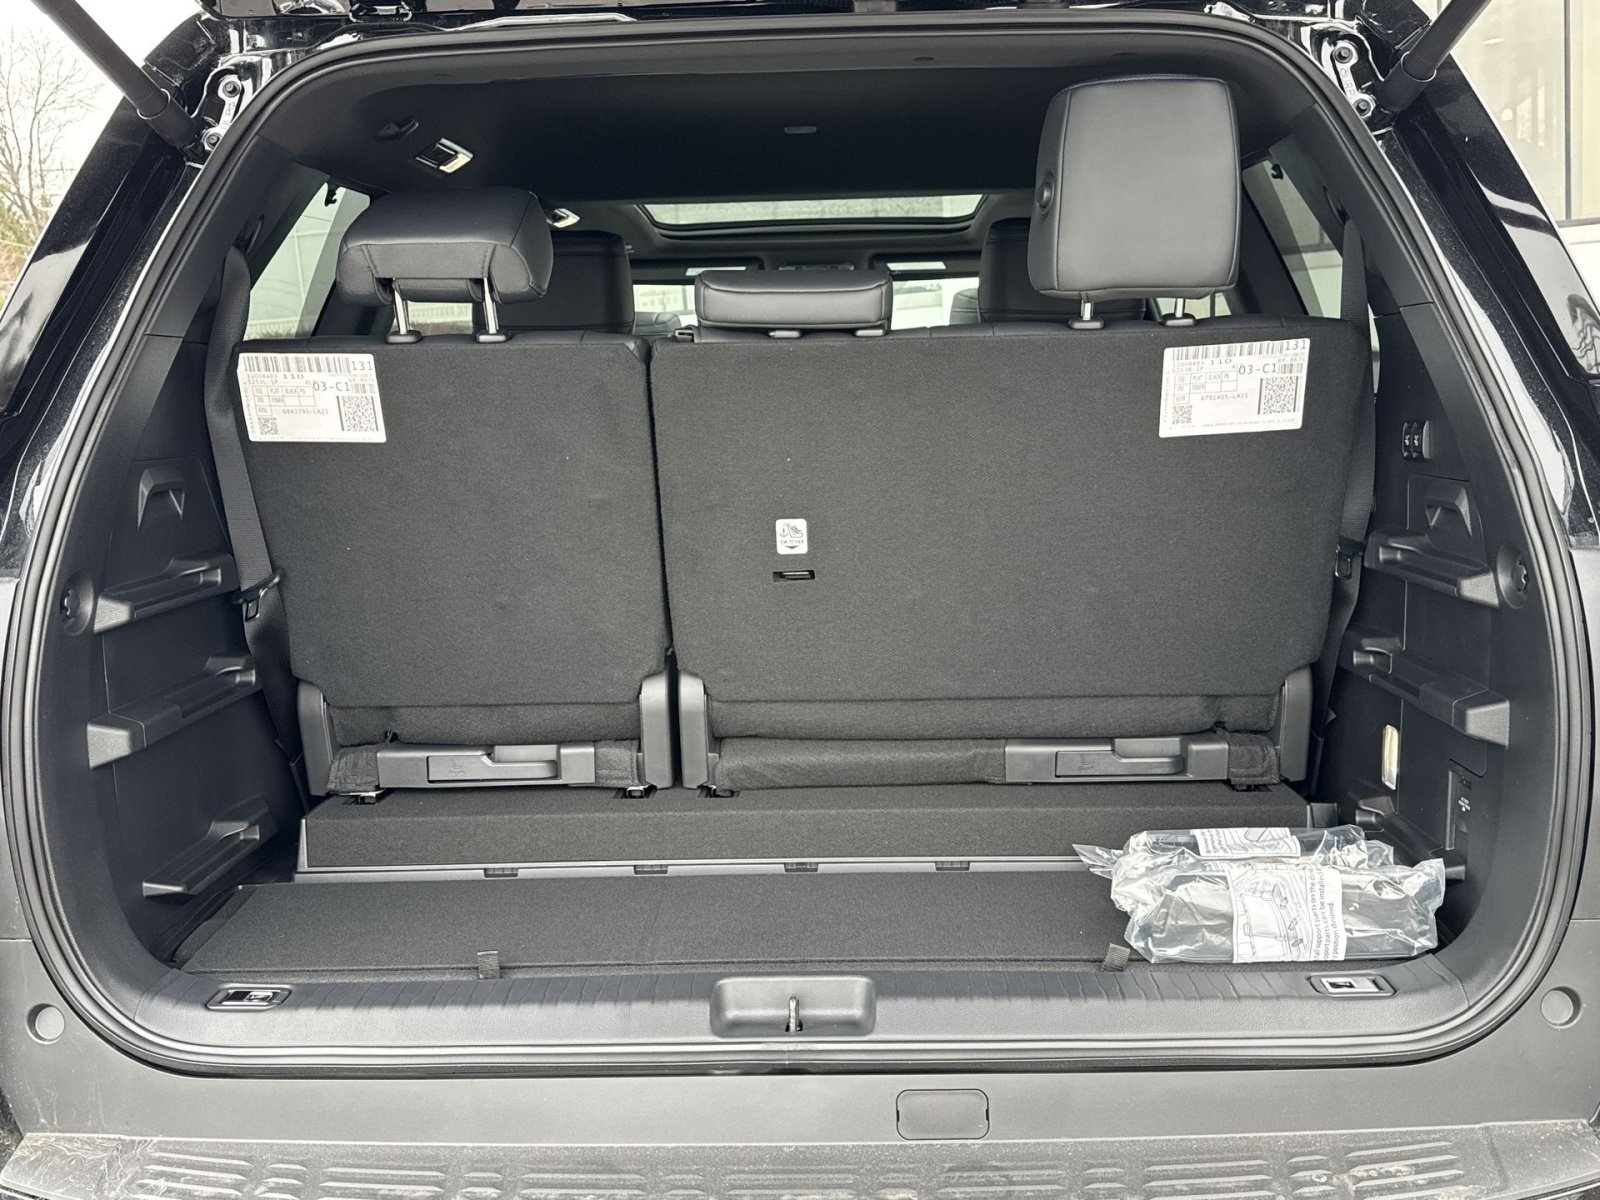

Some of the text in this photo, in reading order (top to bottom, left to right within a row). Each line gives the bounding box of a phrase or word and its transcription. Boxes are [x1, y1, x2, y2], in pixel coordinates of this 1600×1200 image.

[1284, 339, 1306, 350] 131
[351, 360, 373, 371] 131
[1238, 362, 1277, 376] 03-C1
[312, 381, 350, 392] 03-C1
[1308, 882, 1316, 893] the
[1310, 894, 1316, 903] on
[1311, 904, 1320, 923] parts
